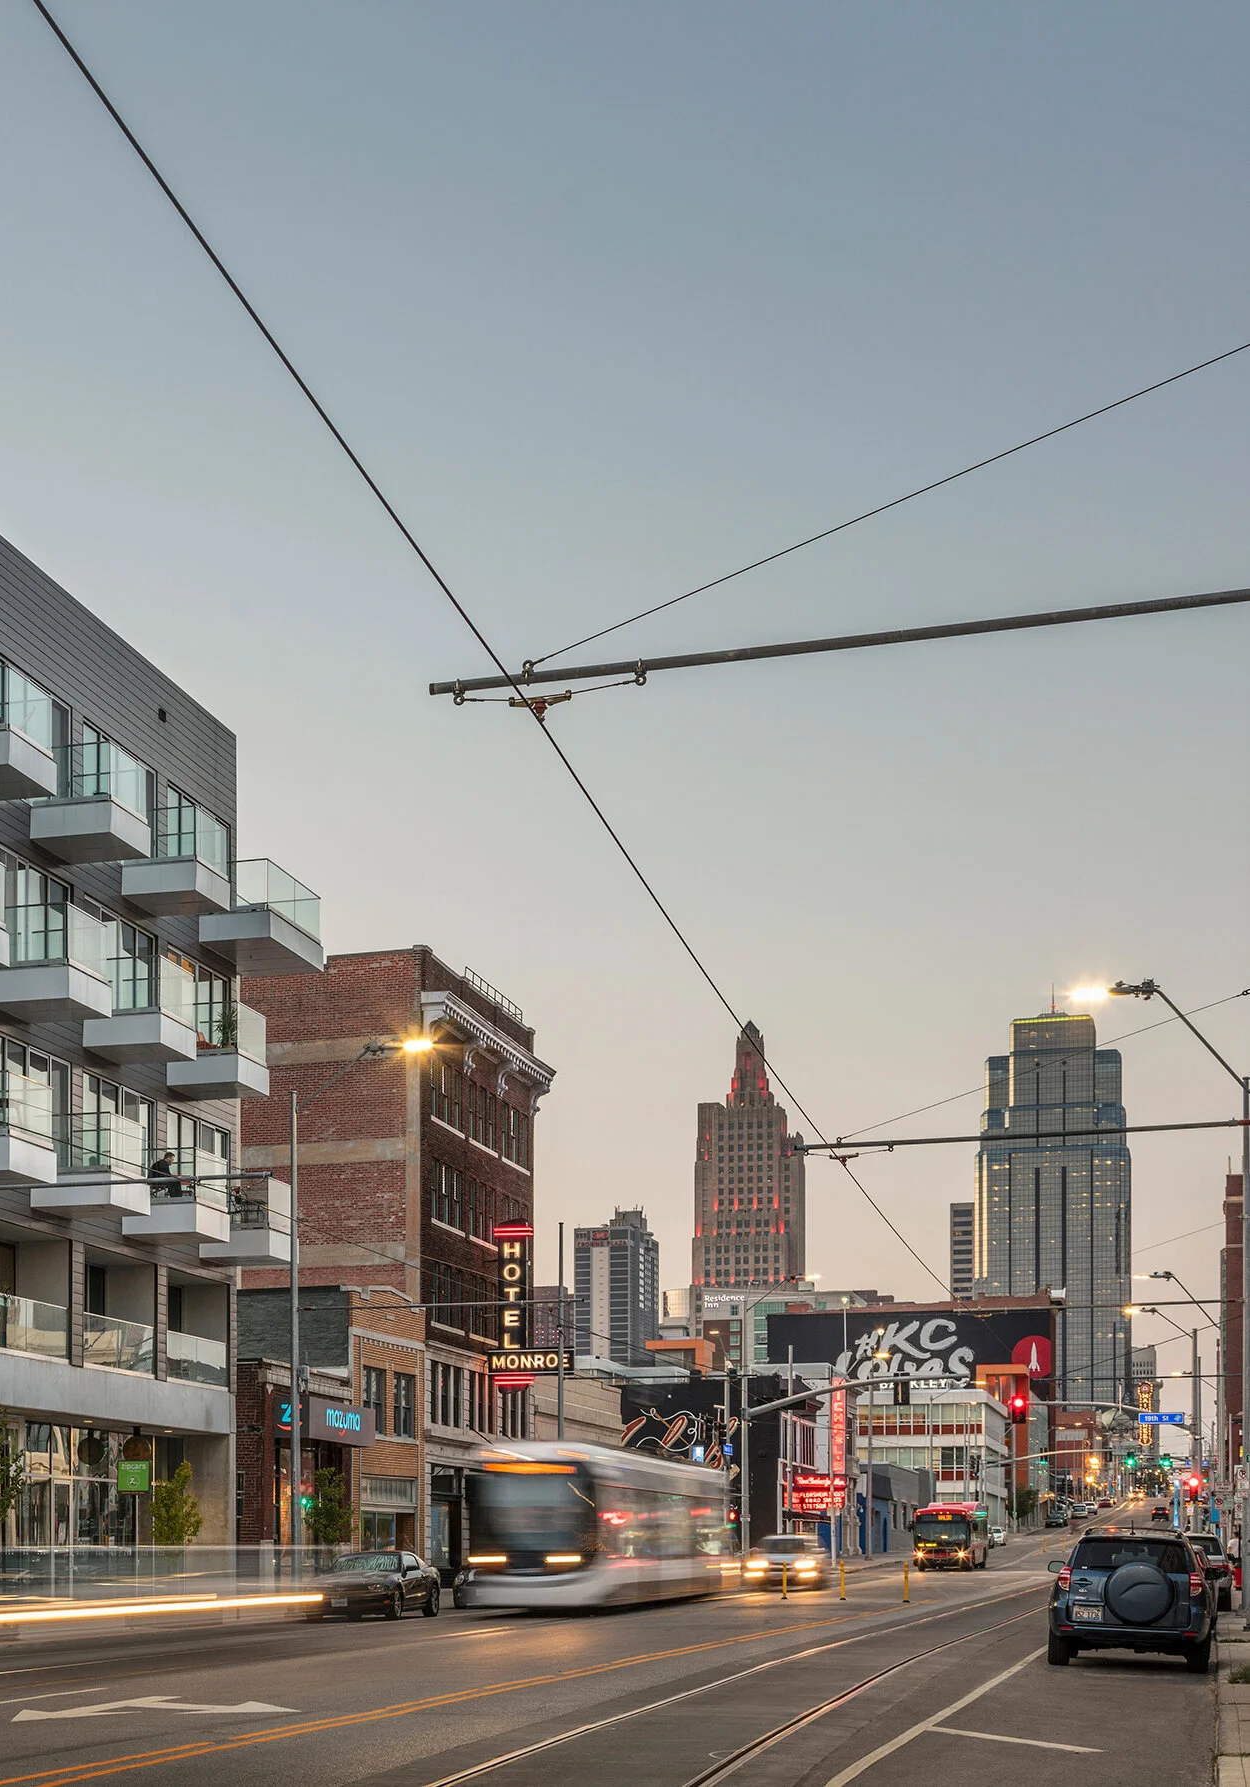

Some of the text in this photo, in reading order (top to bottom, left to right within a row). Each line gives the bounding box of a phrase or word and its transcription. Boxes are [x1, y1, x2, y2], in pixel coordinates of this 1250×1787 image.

[503, 1241, 521, 1349] HOTEL
[704, 1294, 745, 1302] Residence
[492, 1354, 570, 1368] MONROE
[326, 1408, 361, 1432] mazuma
